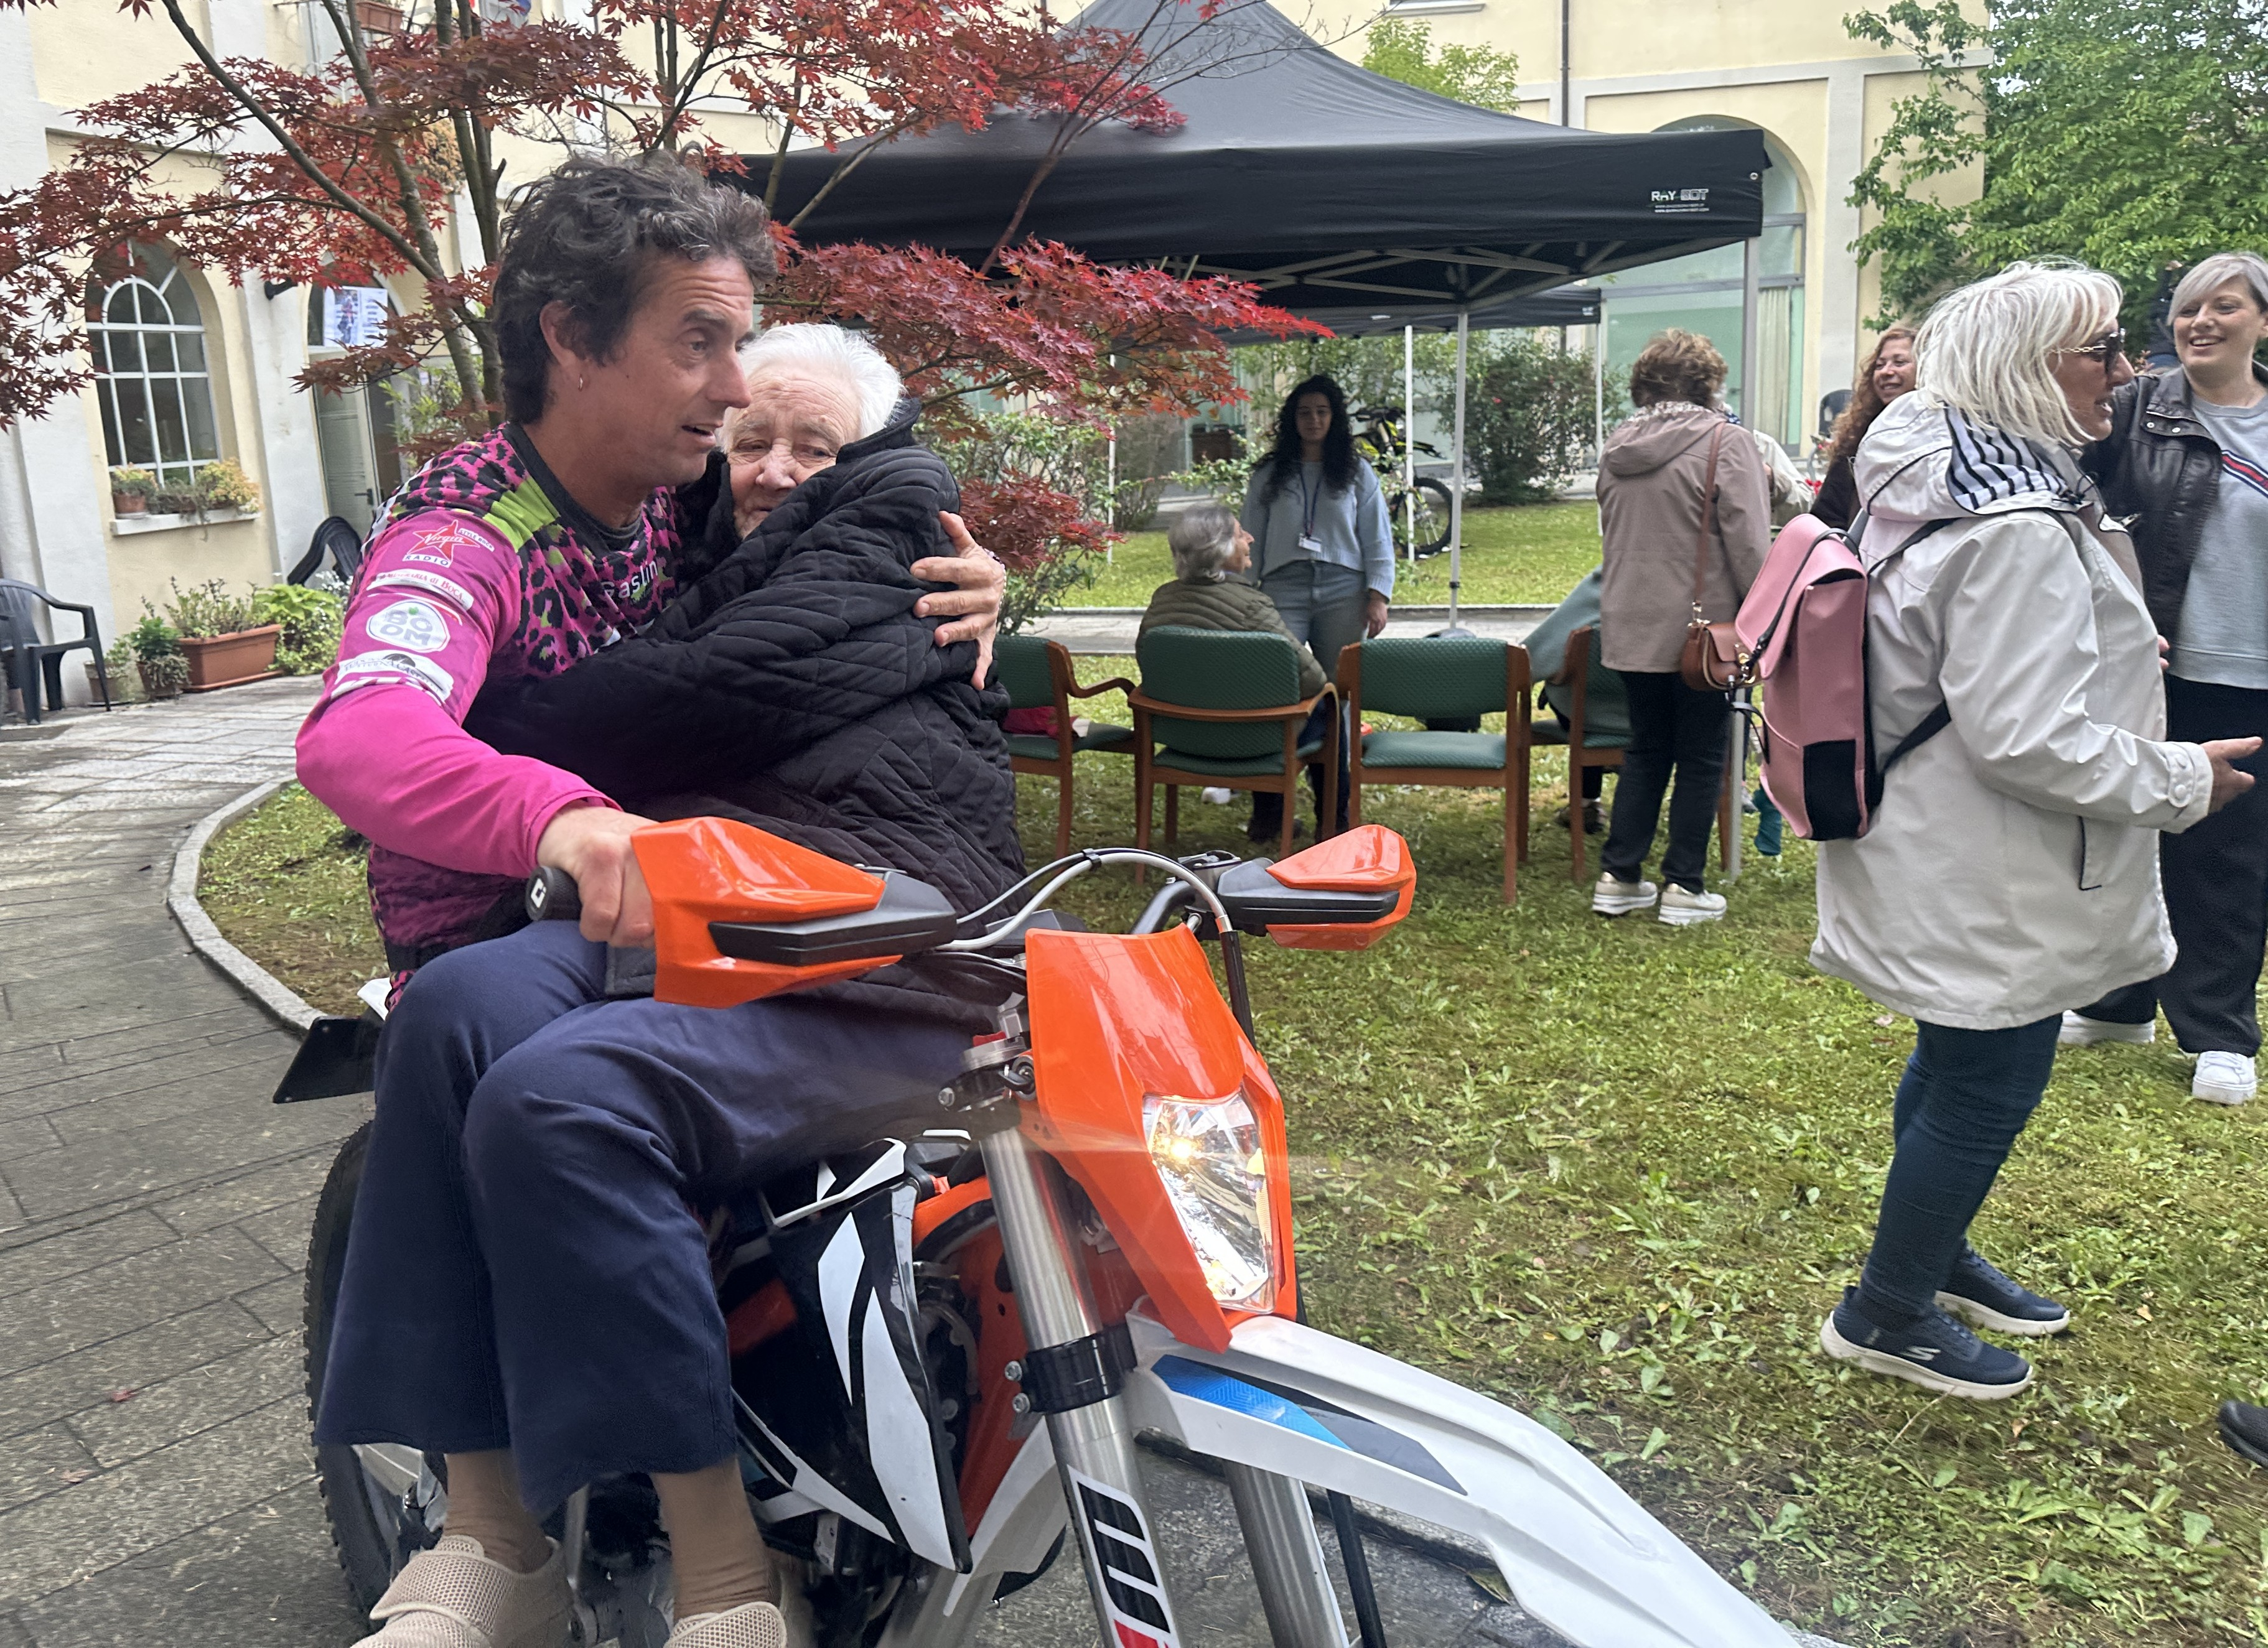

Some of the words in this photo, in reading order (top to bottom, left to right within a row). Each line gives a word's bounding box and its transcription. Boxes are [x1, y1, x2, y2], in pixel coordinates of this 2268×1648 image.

[424, 528, 465, 548] Virgin
[459, 529, 477, 540] STYLE
[405, 555, 449, 566] RADIO
[441, 580, 463, 600] BOCA
